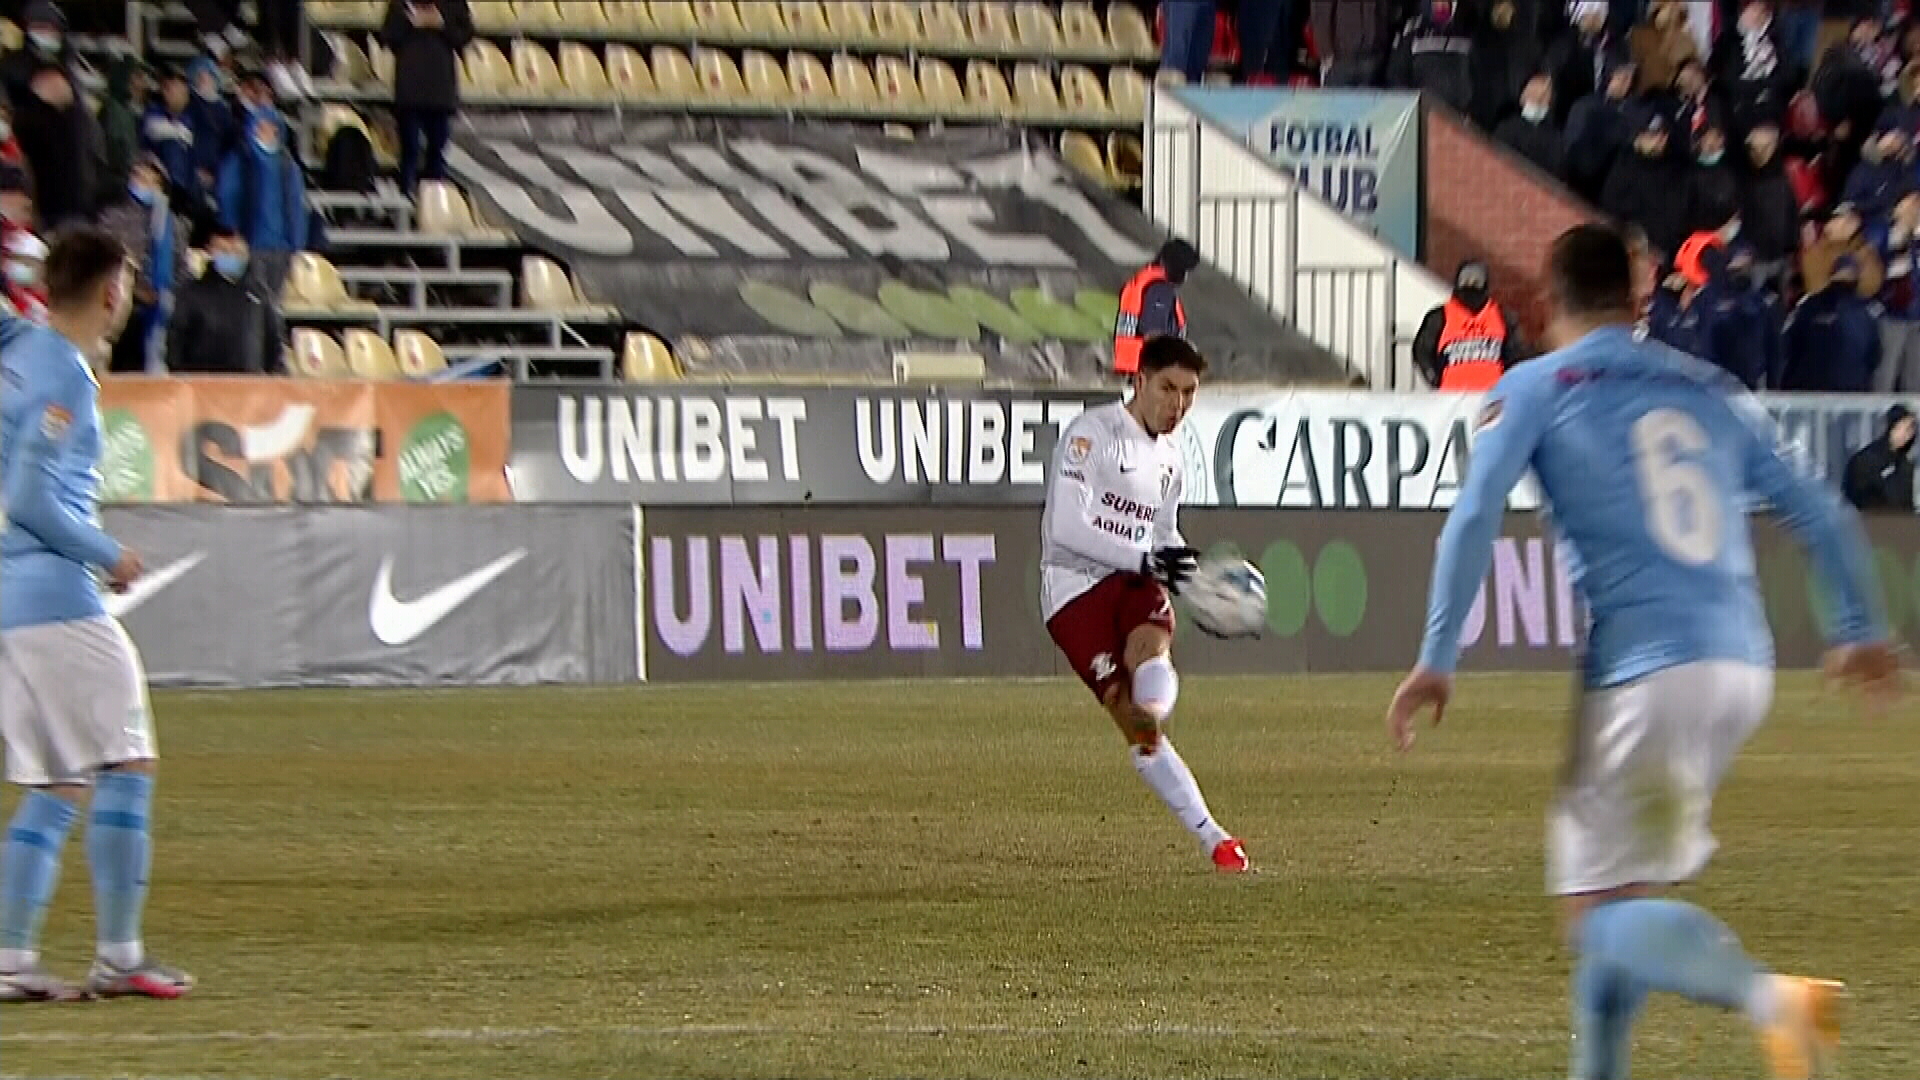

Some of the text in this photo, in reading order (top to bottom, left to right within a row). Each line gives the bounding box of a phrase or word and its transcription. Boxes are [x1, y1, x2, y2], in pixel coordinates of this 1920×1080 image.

[1270, 121, 1379, 158] FOTBAL
[1278, 163, 1378, 215] LUB
[558, 395, 807, 483] UNIBET
[1214, 408, 1472, 510] CARPA
[1630, 408, 1723, 565] 6
[651, 535, 997, 655] UNIBET
